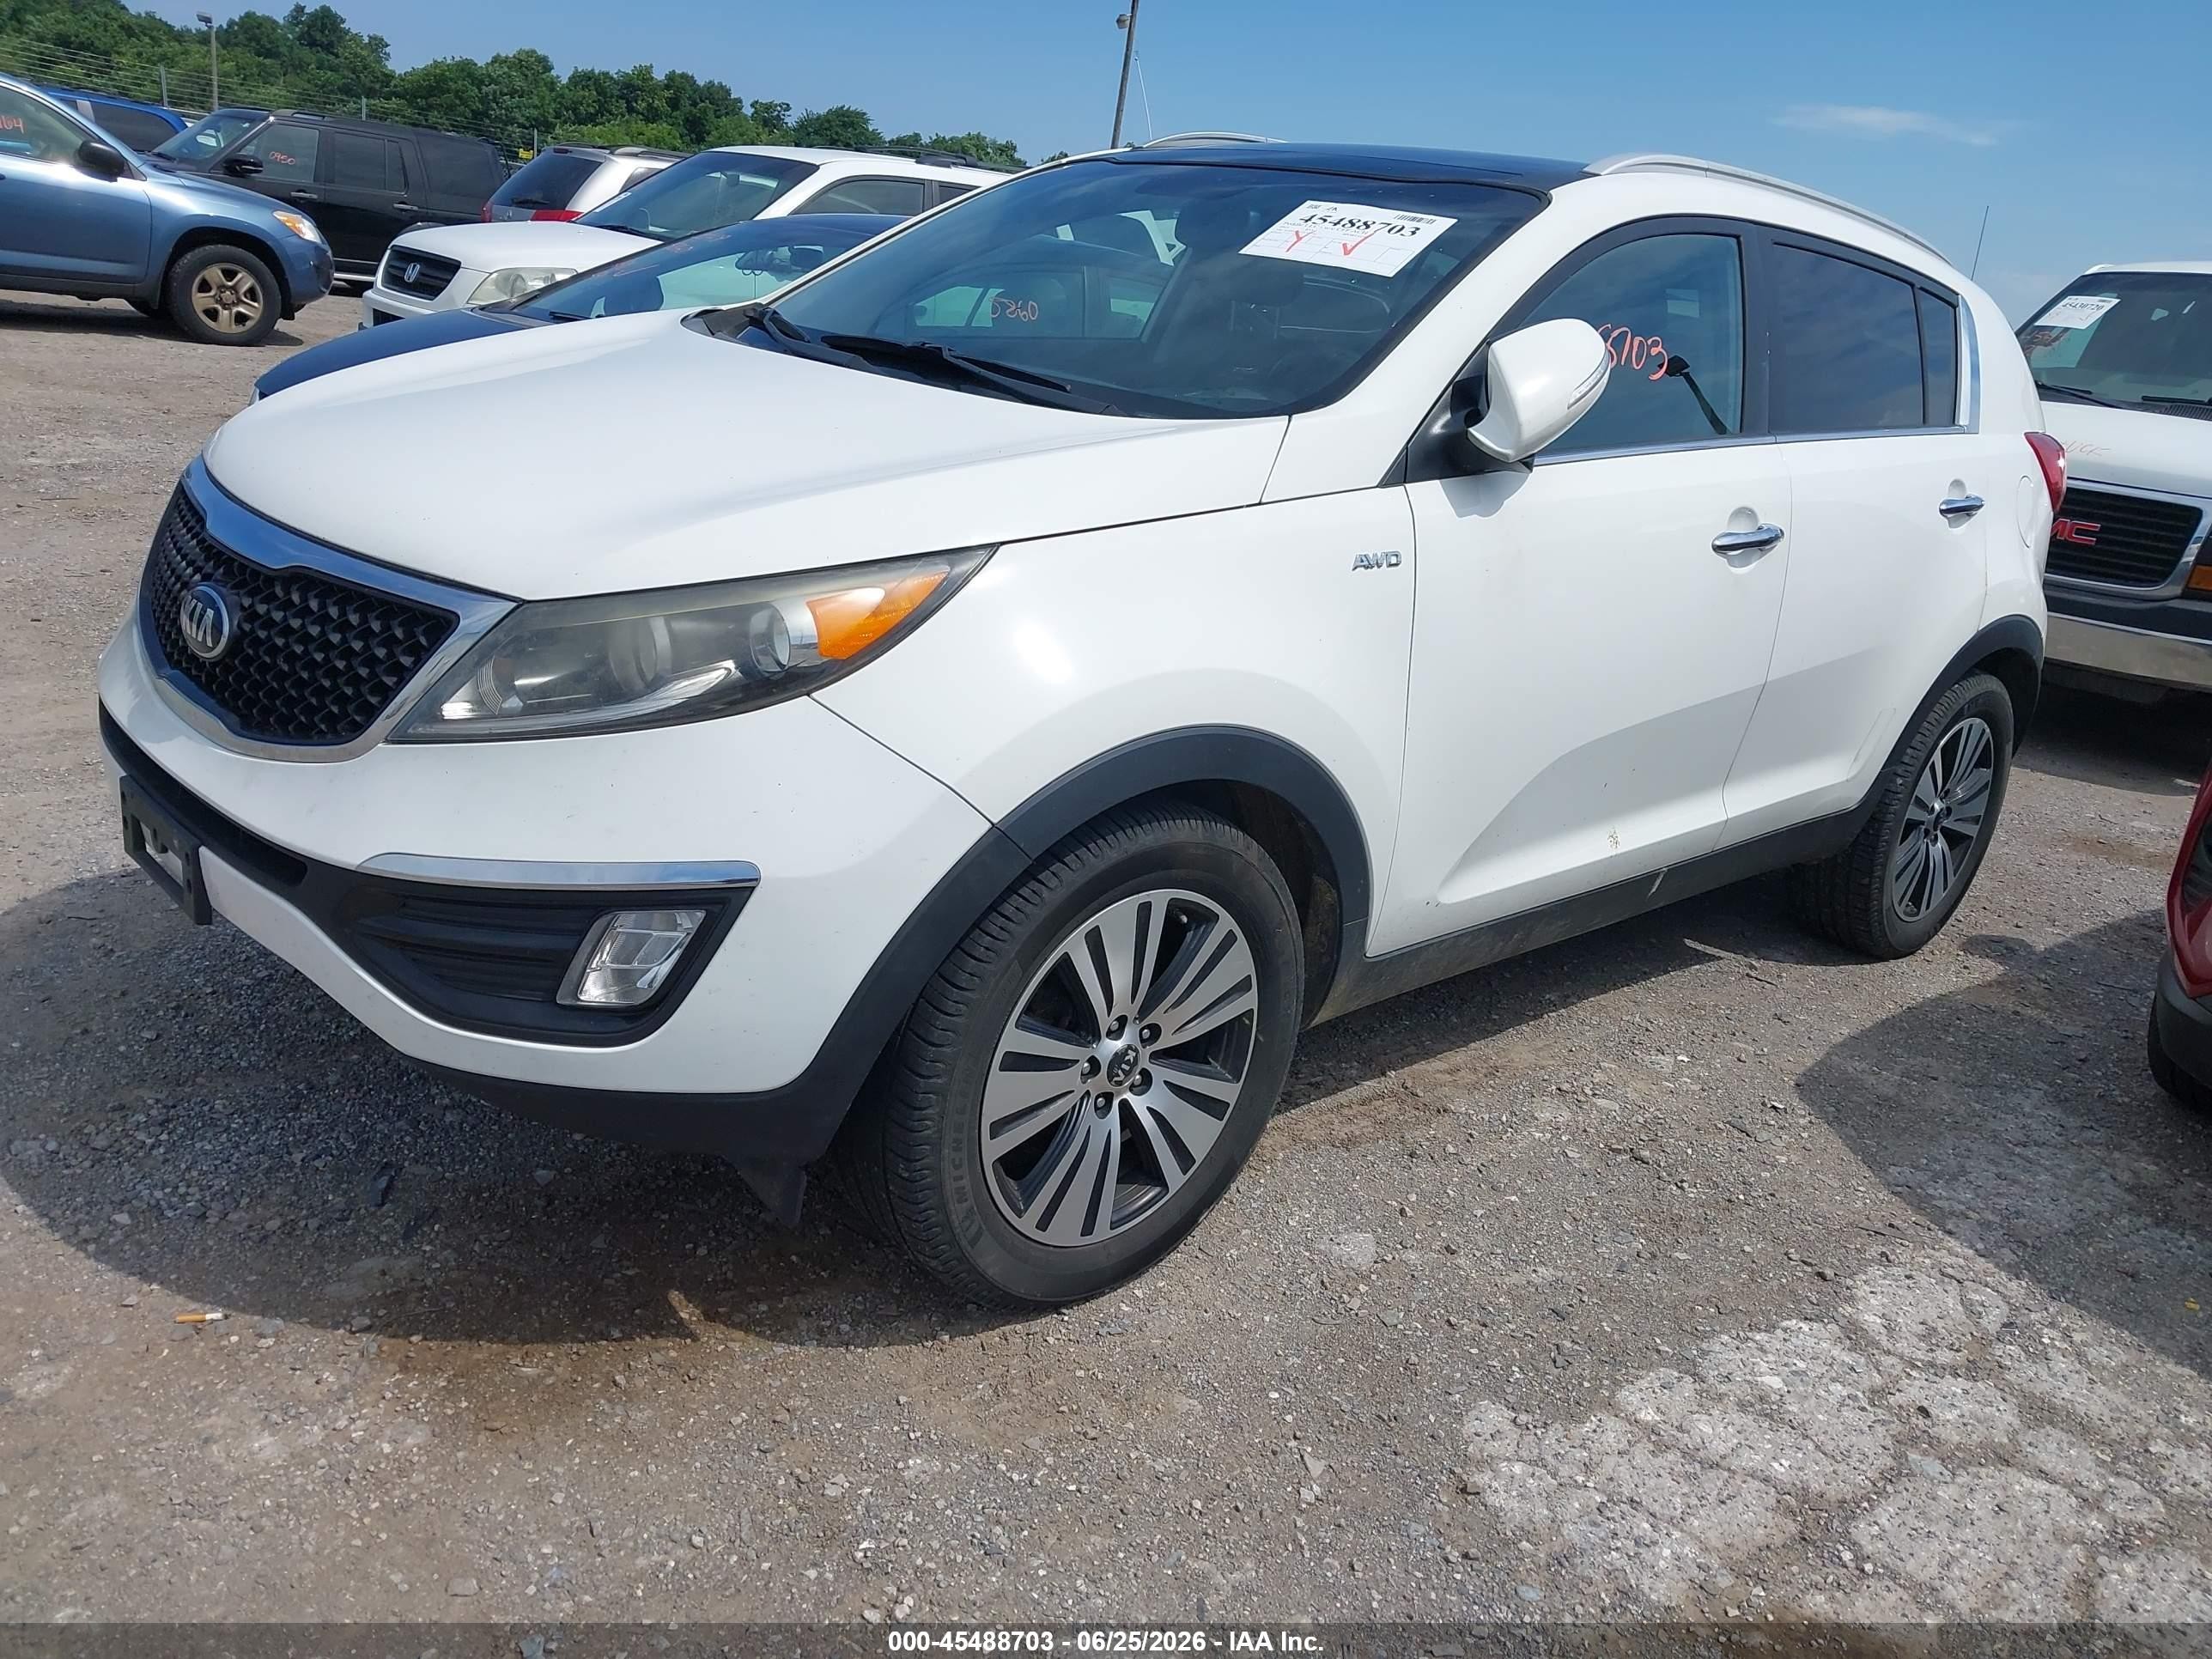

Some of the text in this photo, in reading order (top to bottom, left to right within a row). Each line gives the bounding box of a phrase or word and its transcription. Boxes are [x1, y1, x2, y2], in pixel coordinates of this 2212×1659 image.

[268, 151, 295, 165] 0950
[1299, 214, 1421, 238] 45488703
[2051, 518, 2101, 545] MC
[1352, 550, 1402, 571] AWD
[183, 594, 215, 648] KIA
[1112, 1049, 1137, 1082] KIA
